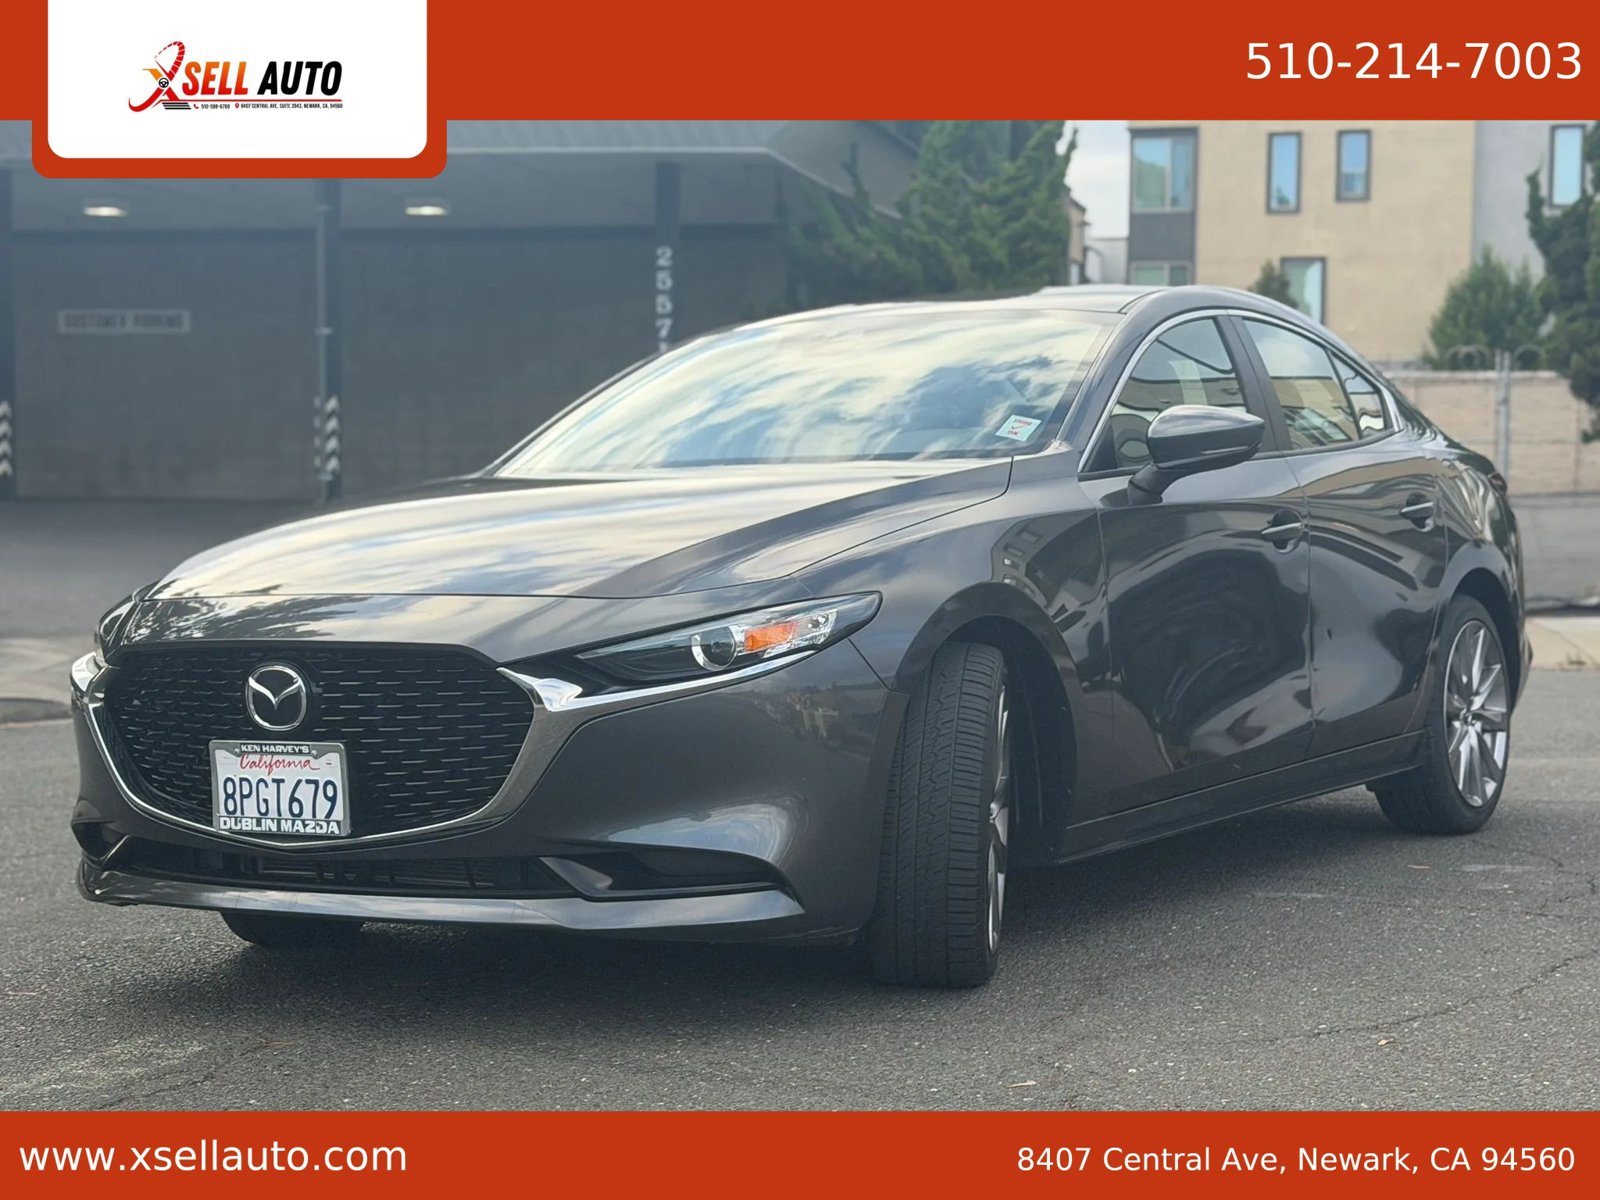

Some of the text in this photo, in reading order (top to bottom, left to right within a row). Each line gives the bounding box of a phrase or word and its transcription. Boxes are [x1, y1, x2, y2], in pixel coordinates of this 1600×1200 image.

[241, 744, 310, 754] KEN HARVEY'S
[240, 753, 320, 776] California
[223, 776, 338, 820] 8PGT679
[219, 817, 340, 835] DUBLIN MAZDA
